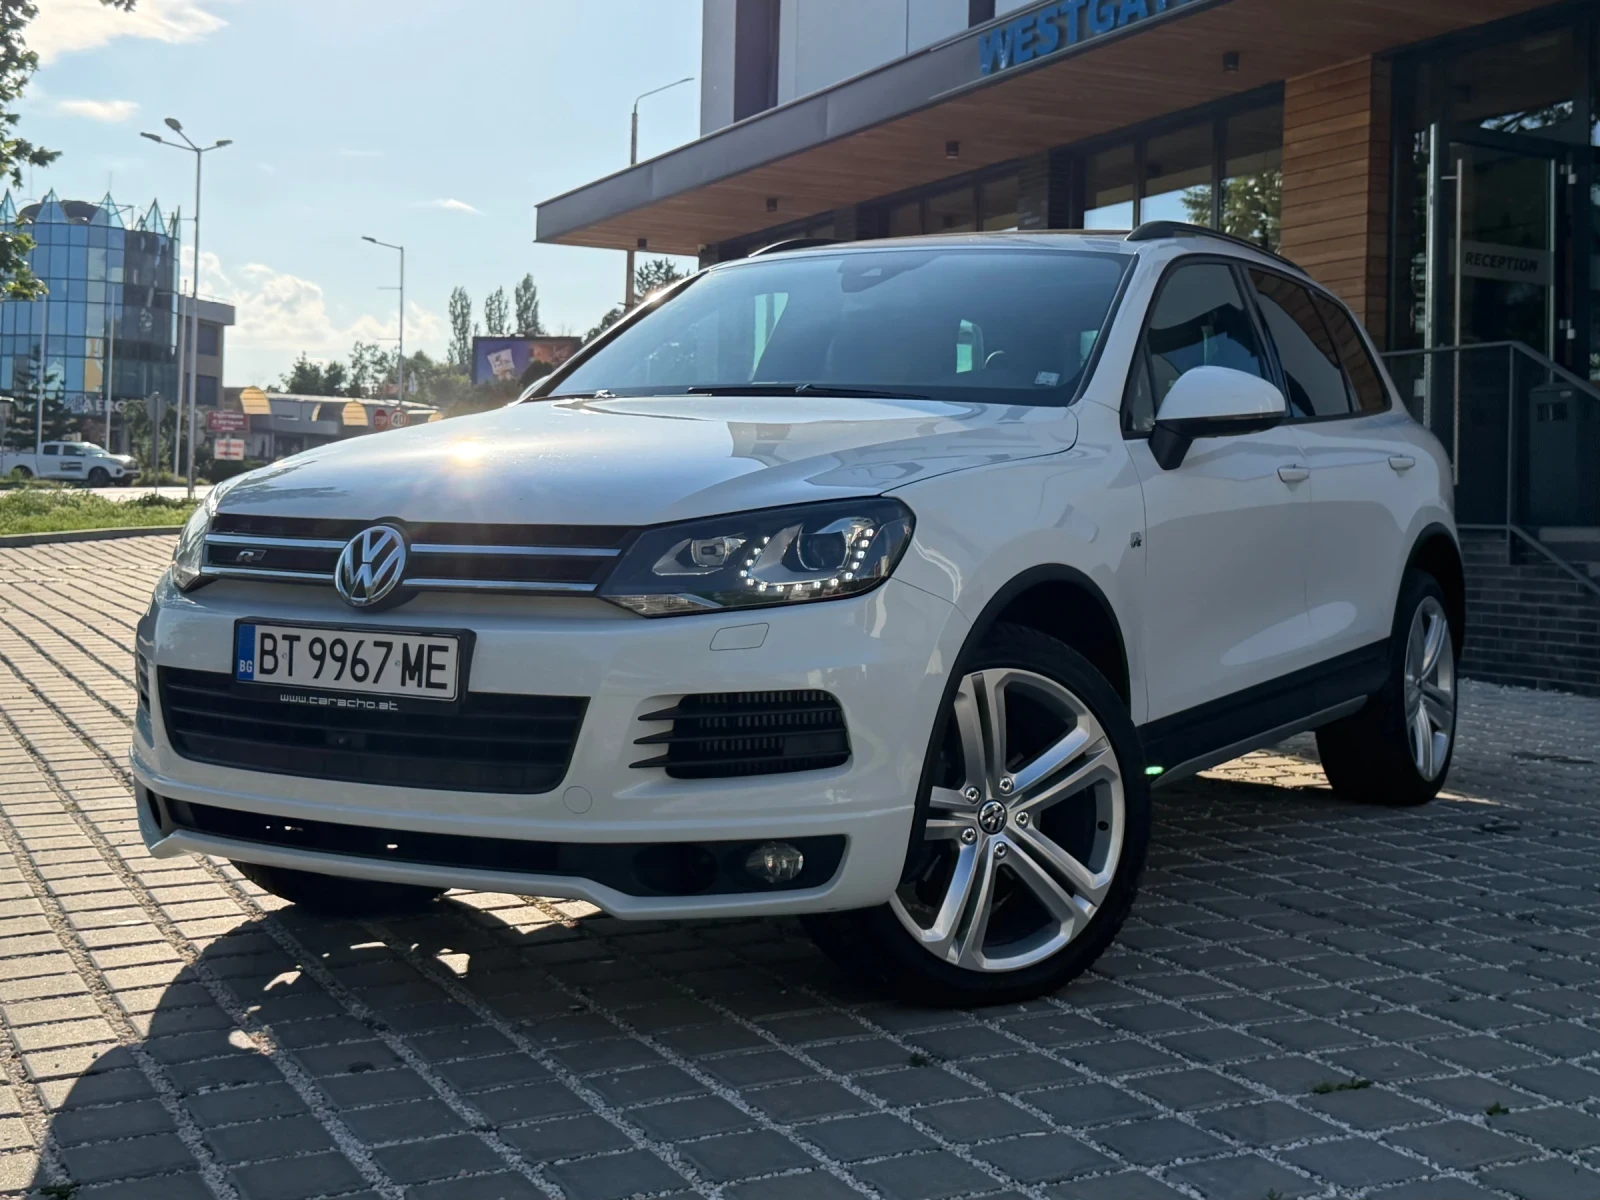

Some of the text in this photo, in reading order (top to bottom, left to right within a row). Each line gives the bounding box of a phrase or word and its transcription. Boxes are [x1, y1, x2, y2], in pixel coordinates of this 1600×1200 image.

[977, 0, 1167, 76] WESTGA
[1465, 251, 1538, 273] RECEPTION
[393, 414, 405, 425] 40
[239, 660, 254, 673] BG
[259, 632, 450, 690] BT 9967 ME
[280, 693, 399, 711] www.caracho.at
